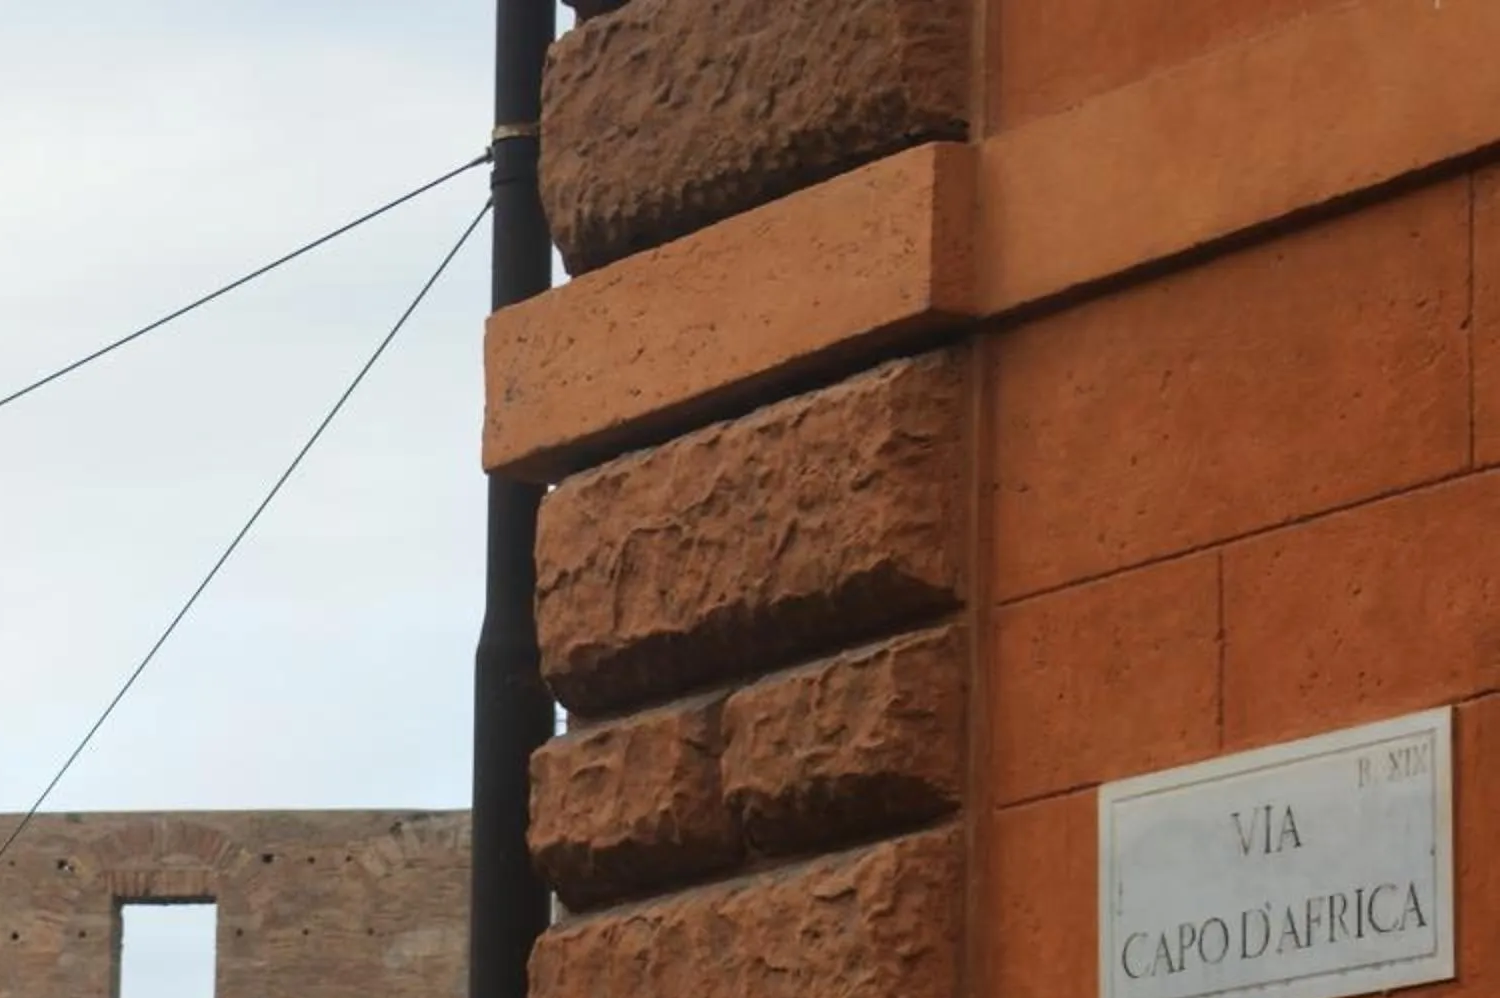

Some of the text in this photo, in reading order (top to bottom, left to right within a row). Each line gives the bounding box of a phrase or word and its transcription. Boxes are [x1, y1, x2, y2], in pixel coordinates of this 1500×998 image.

[1231, 804, 1303, 857] VIA
[1121, 880, 1427, 980] CAPO D'AFRICA
